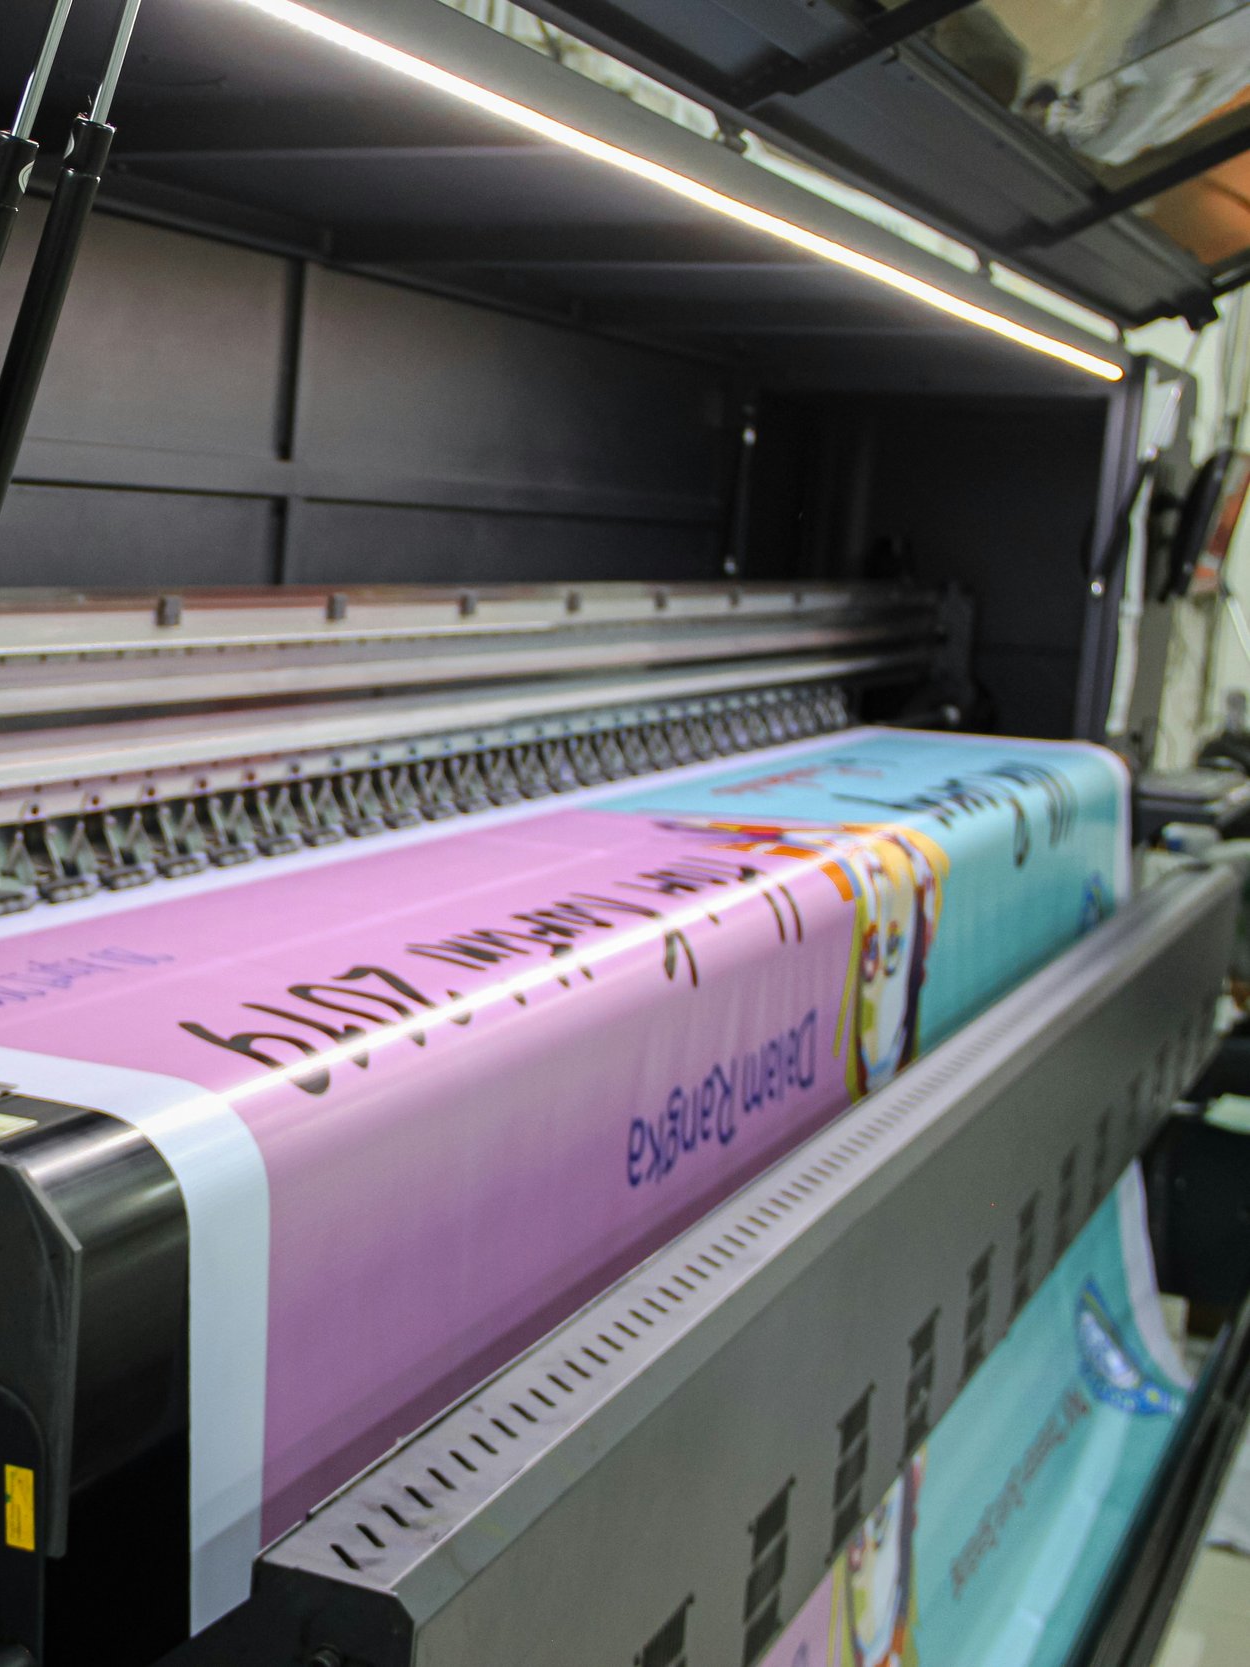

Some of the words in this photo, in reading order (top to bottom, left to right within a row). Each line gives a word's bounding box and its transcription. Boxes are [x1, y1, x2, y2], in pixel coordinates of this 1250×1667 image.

[177, 965, 473, 1095] 2019
[742, 1008, 817, 1114] Dalam
[627, 1062, 736, 1187] Rangka
